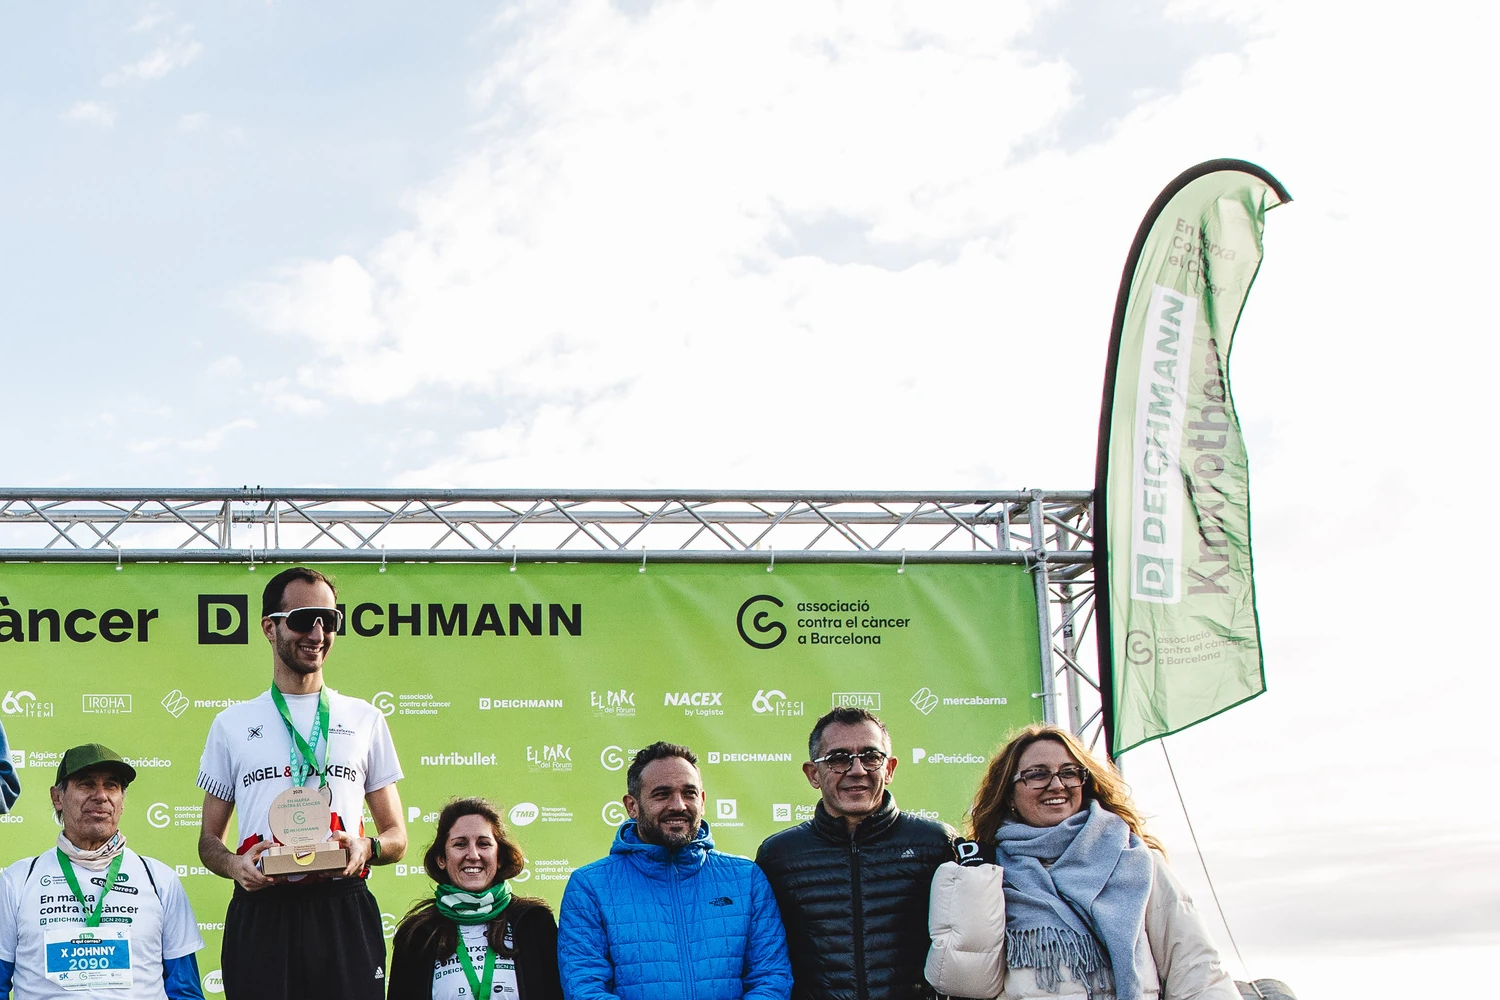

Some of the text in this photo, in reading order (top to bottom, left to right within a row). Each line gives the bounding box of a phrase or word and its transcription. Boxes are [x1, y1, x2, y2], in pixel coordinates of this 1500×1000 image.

[1176, 217, 1194, 237] En
[1168, 255, 1184, 269] el
[1143, 295, 1185, 544] DEICHMANN
[797, 600, 870, 612] associació
[337, 603, 582, 637] ICHMANN
[797, 616, 910, 628] contra el càncer
[798, 632, 881, 644] a Barcelona
[1157, 631, 1211, 643] associació
[1158, 645, 1190, 654] contra
[1194, 643, 1202, 651] el
[1167, 651, 1220, 665] Barcelona
[90, 696, 125, 708] IROHA
[494, 700, 562, 708] DEICHMANN
[591, 691, 607, 711] EL
[664, 692, 722, 706] NACEX
[839, 695, 874, 706] IROHA
[943, 696, 1007, 705] mercabarna
[723, 753, 791, 761] DEICHMANN
[928, 753, 985, 763] elPeriódico
[243, 766, 282, 788] ENGEL
[284, 766, 292, 777] &
[40, 894, 95, 904] En maxa
[40, 904, 79, 915] contra
[61, 946, 115, 958] X JOHNNY
[69, 958, 109, 970] 2090
